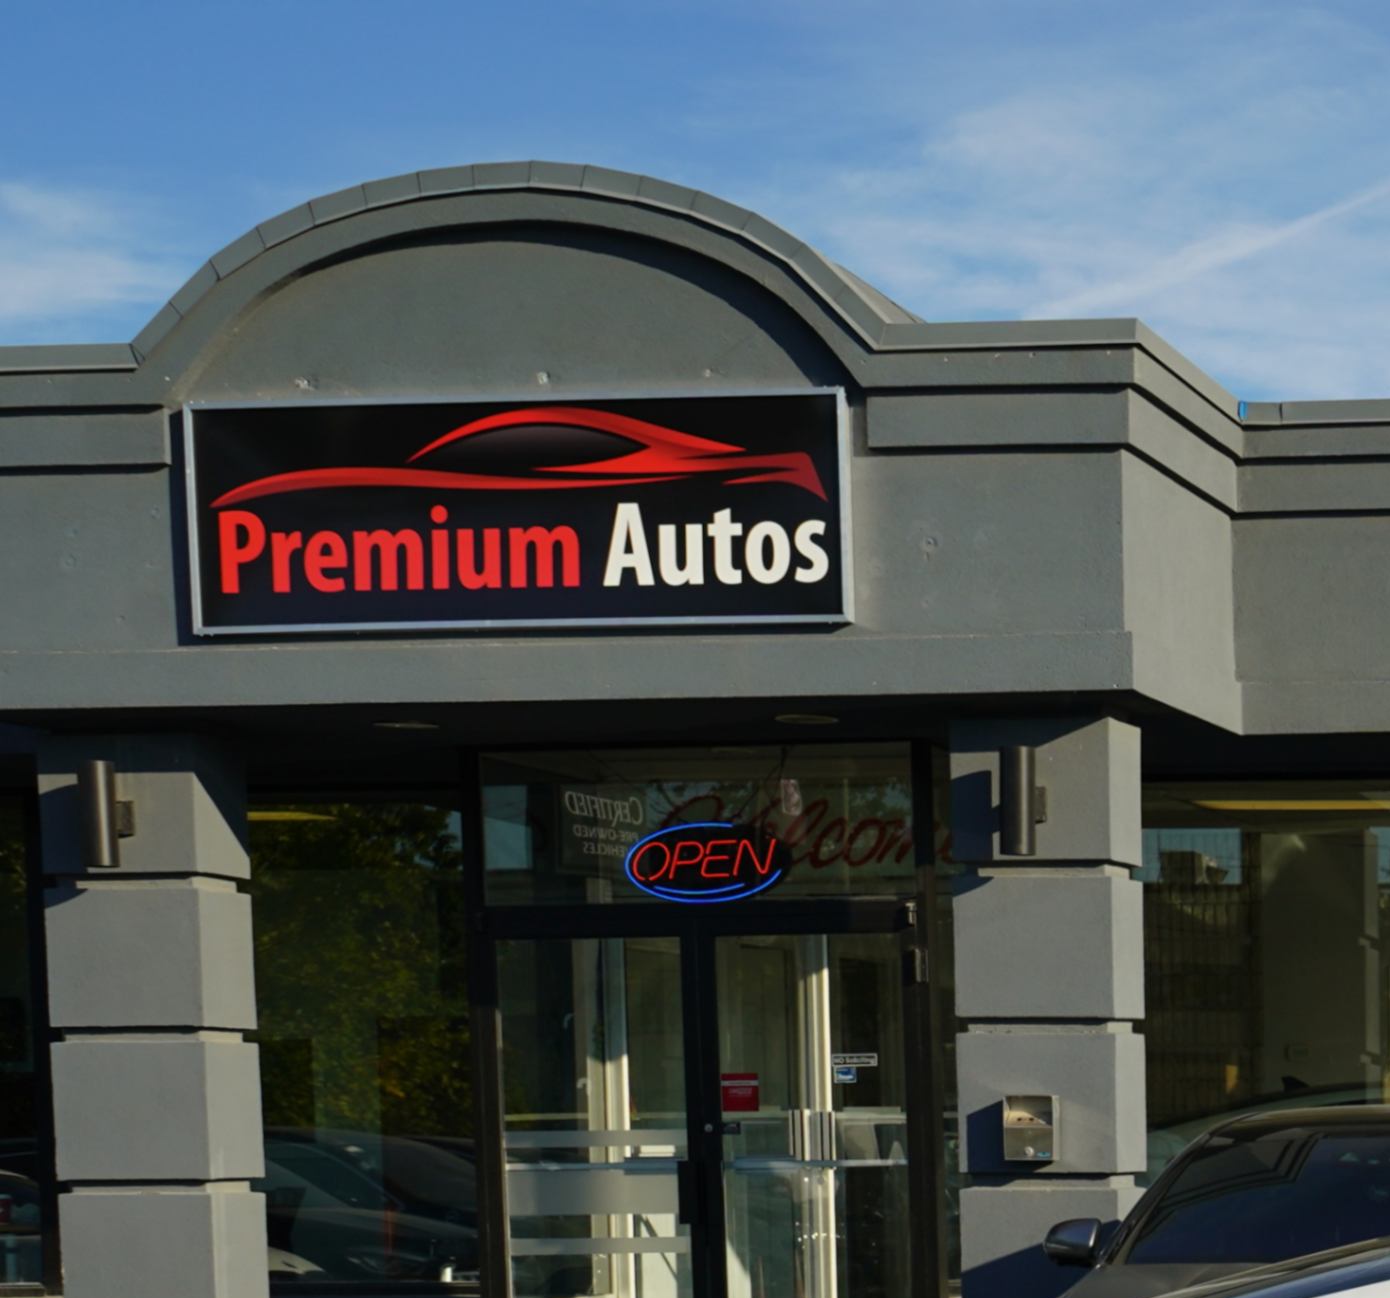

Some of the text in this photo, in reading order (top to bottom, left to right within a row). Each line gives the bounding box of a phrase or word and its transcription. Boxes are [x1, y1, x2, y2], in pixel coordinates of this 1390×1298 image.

[218, 502, 829, 593] Premium Autos
[632, 838, 776, 881] OPEN
